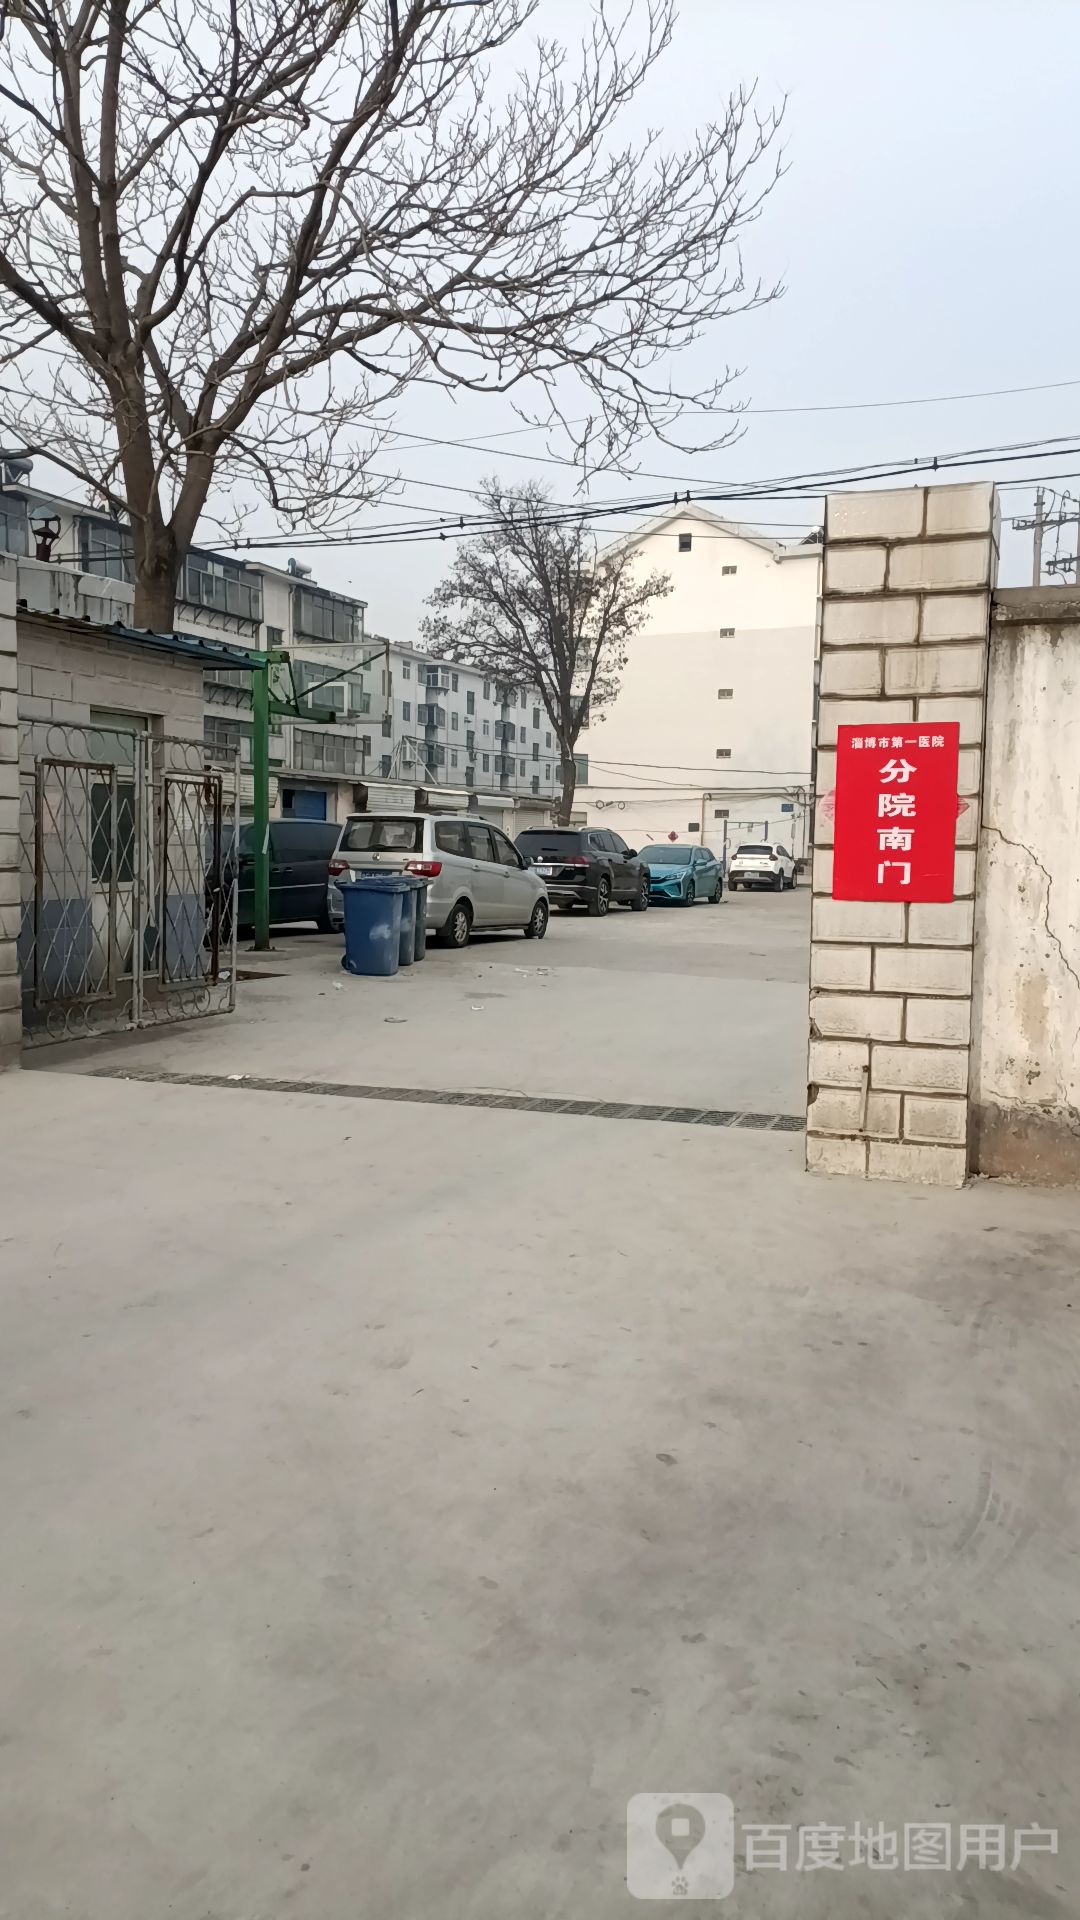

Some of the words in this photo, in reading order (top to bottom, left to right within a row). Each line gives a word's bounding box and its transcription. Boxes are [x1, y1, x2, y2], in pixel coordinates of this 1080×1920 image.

[851, 735, 945, 749] 淄博市第一医院
[877, 759, 917, 885] 分院南门
